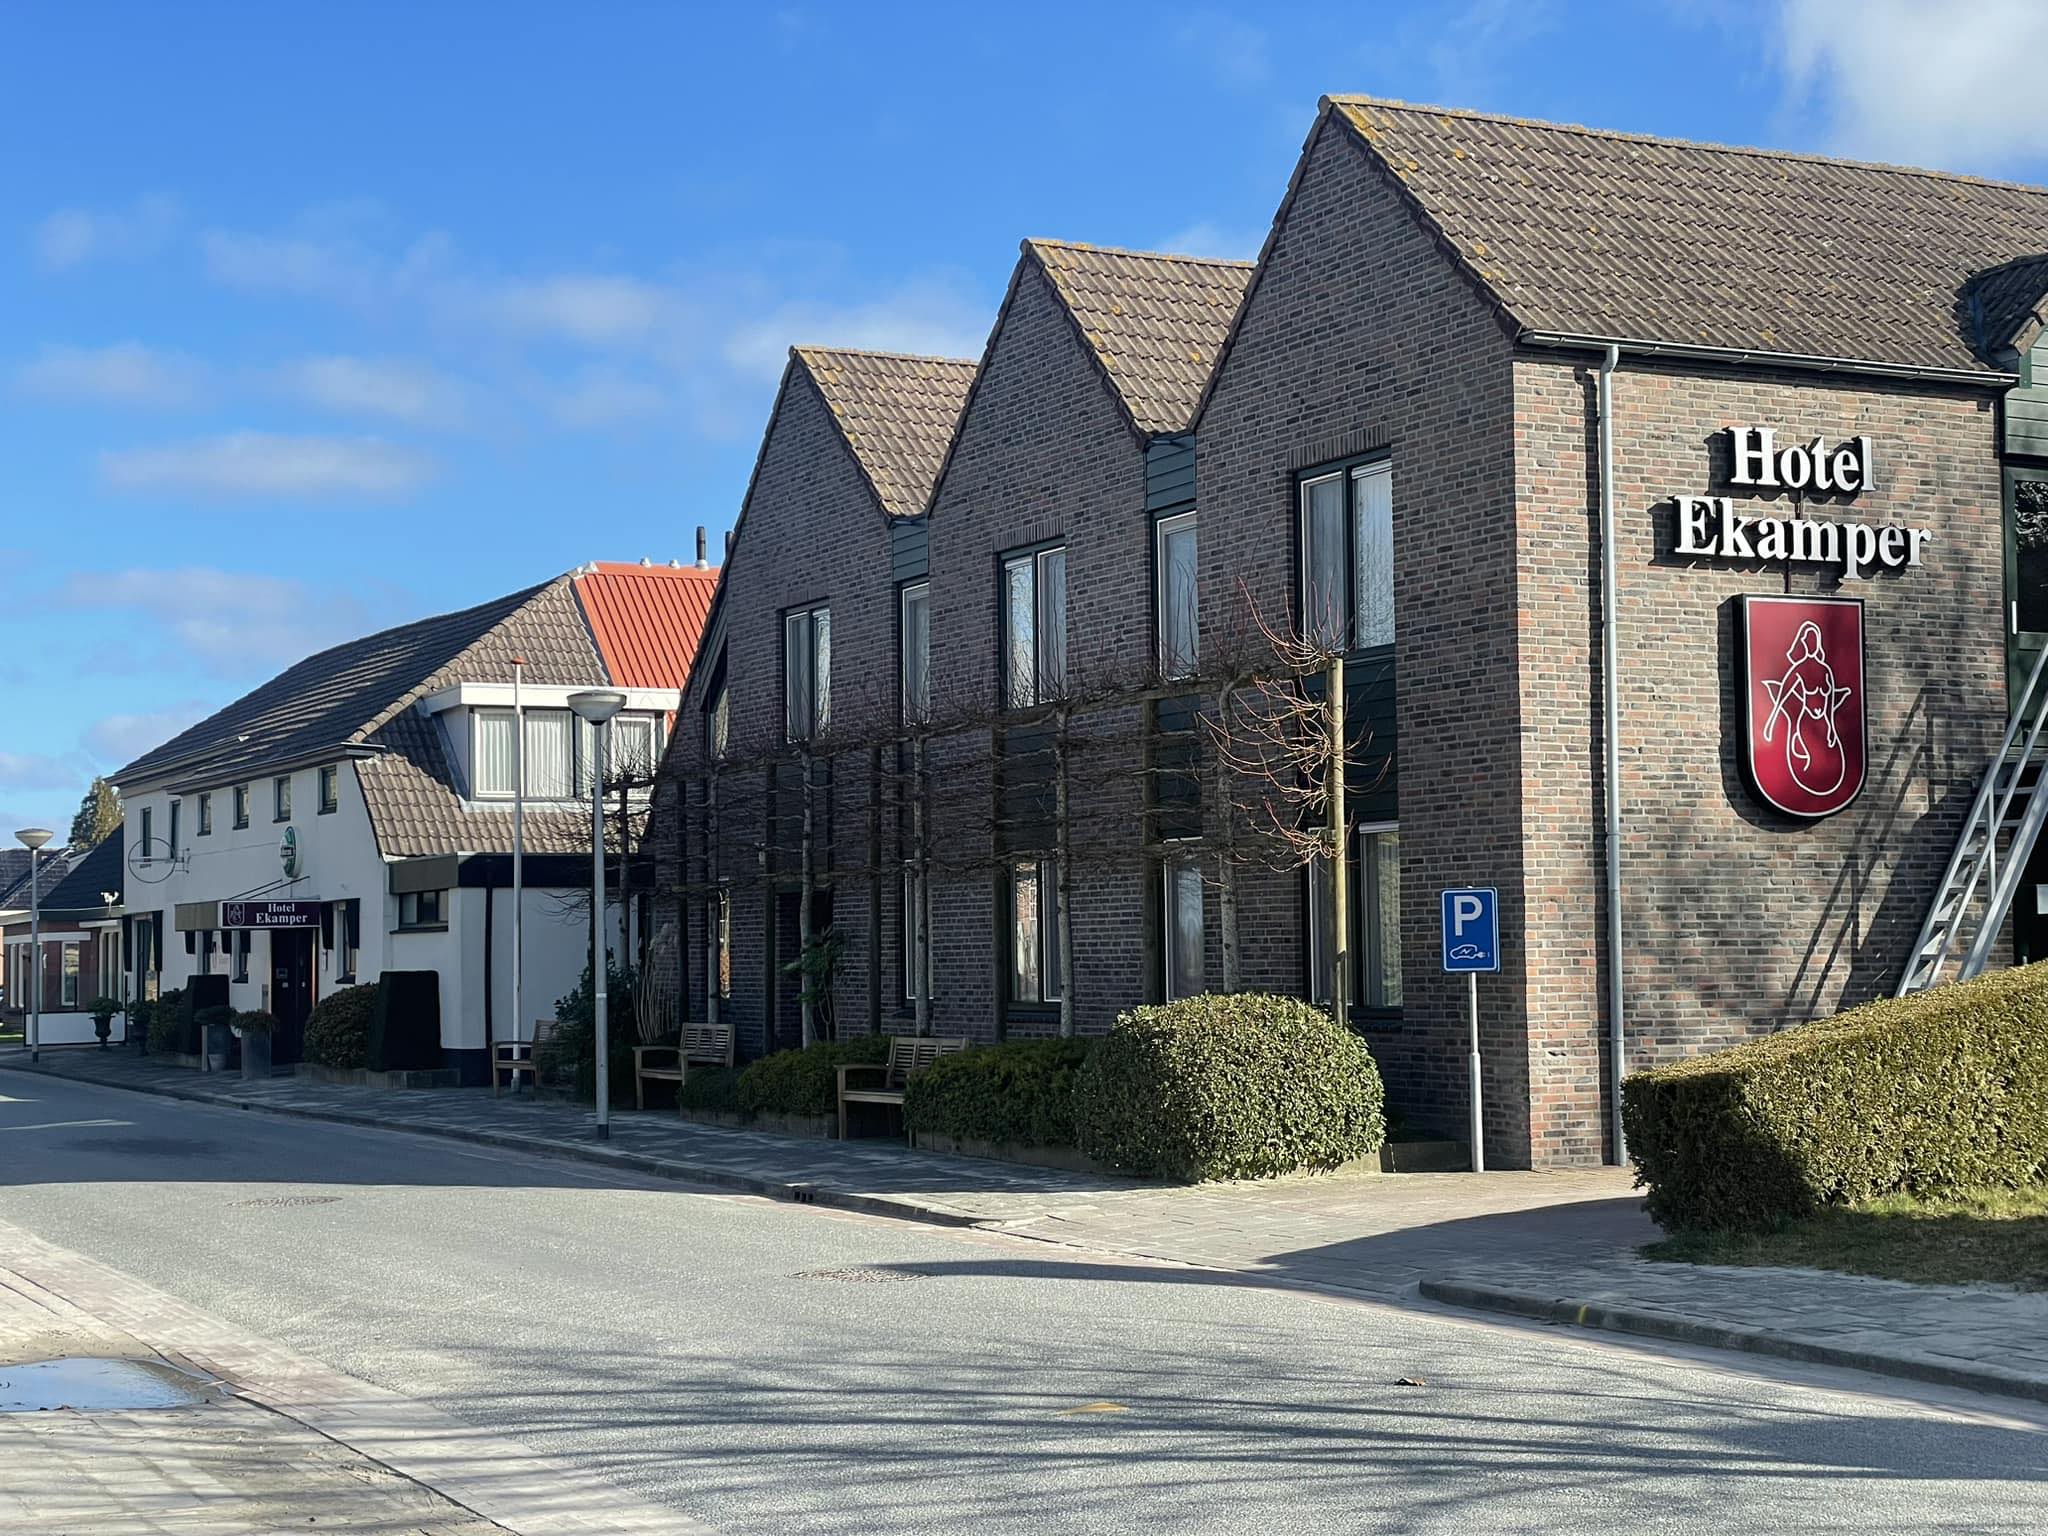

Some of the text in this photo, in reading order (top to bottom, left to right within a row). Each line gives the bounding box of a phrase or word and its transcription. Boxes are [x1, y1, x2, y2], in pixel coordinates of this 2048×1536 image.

[1729, 426, 1876, 491] Hotel
[1673, 495, 1932, 579] Ekamper
[256, 912, 308, 925] Ekamper
[268, 903, 295, 913] Hotel
[1454, 895, 1483, 937] P
